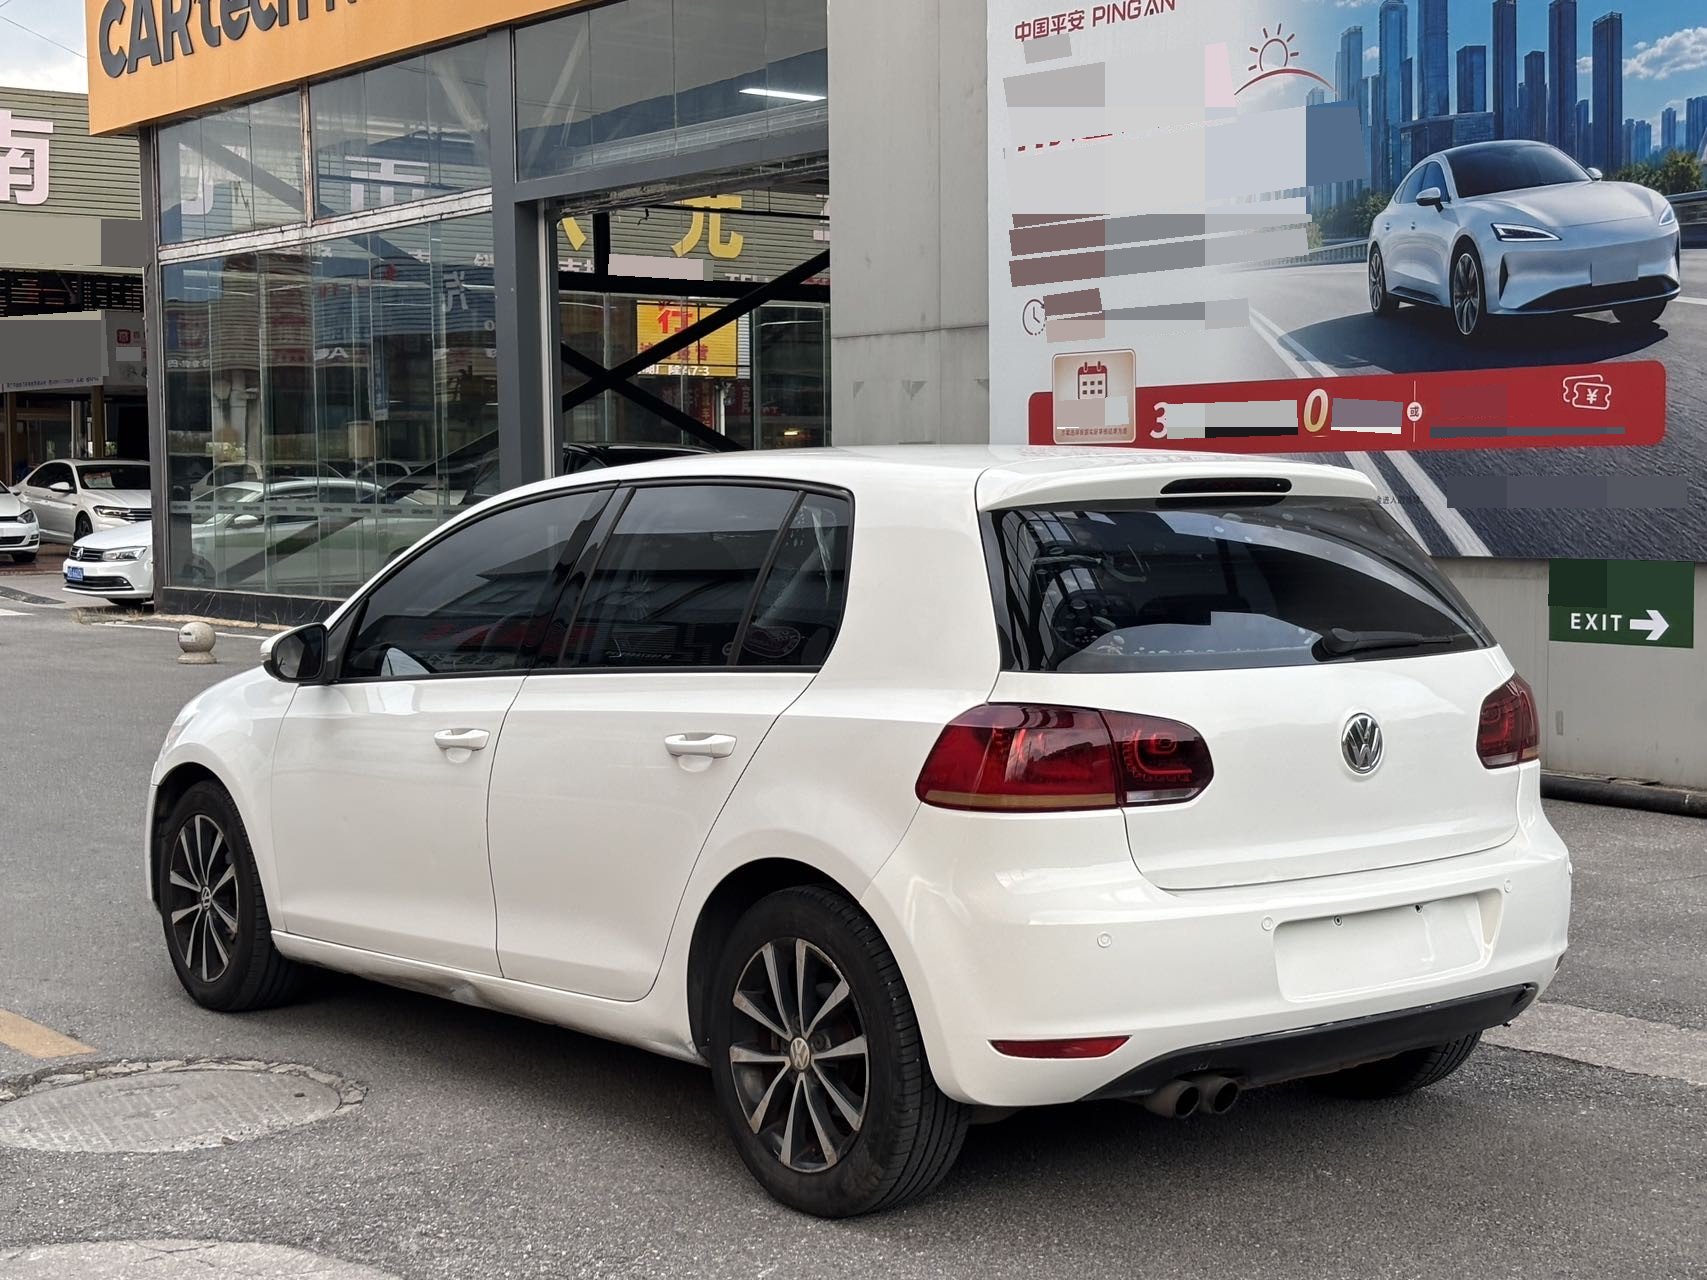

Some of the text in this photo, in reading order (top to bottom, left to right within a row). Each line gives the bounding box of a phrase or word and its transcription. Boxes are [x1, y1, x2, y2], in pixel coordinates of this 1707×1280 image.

[1015, 10, 1085, 42] 中国平安
[1409, 405, 1420, 417] 或
[1570, 612, 1622, 631] EXIT
